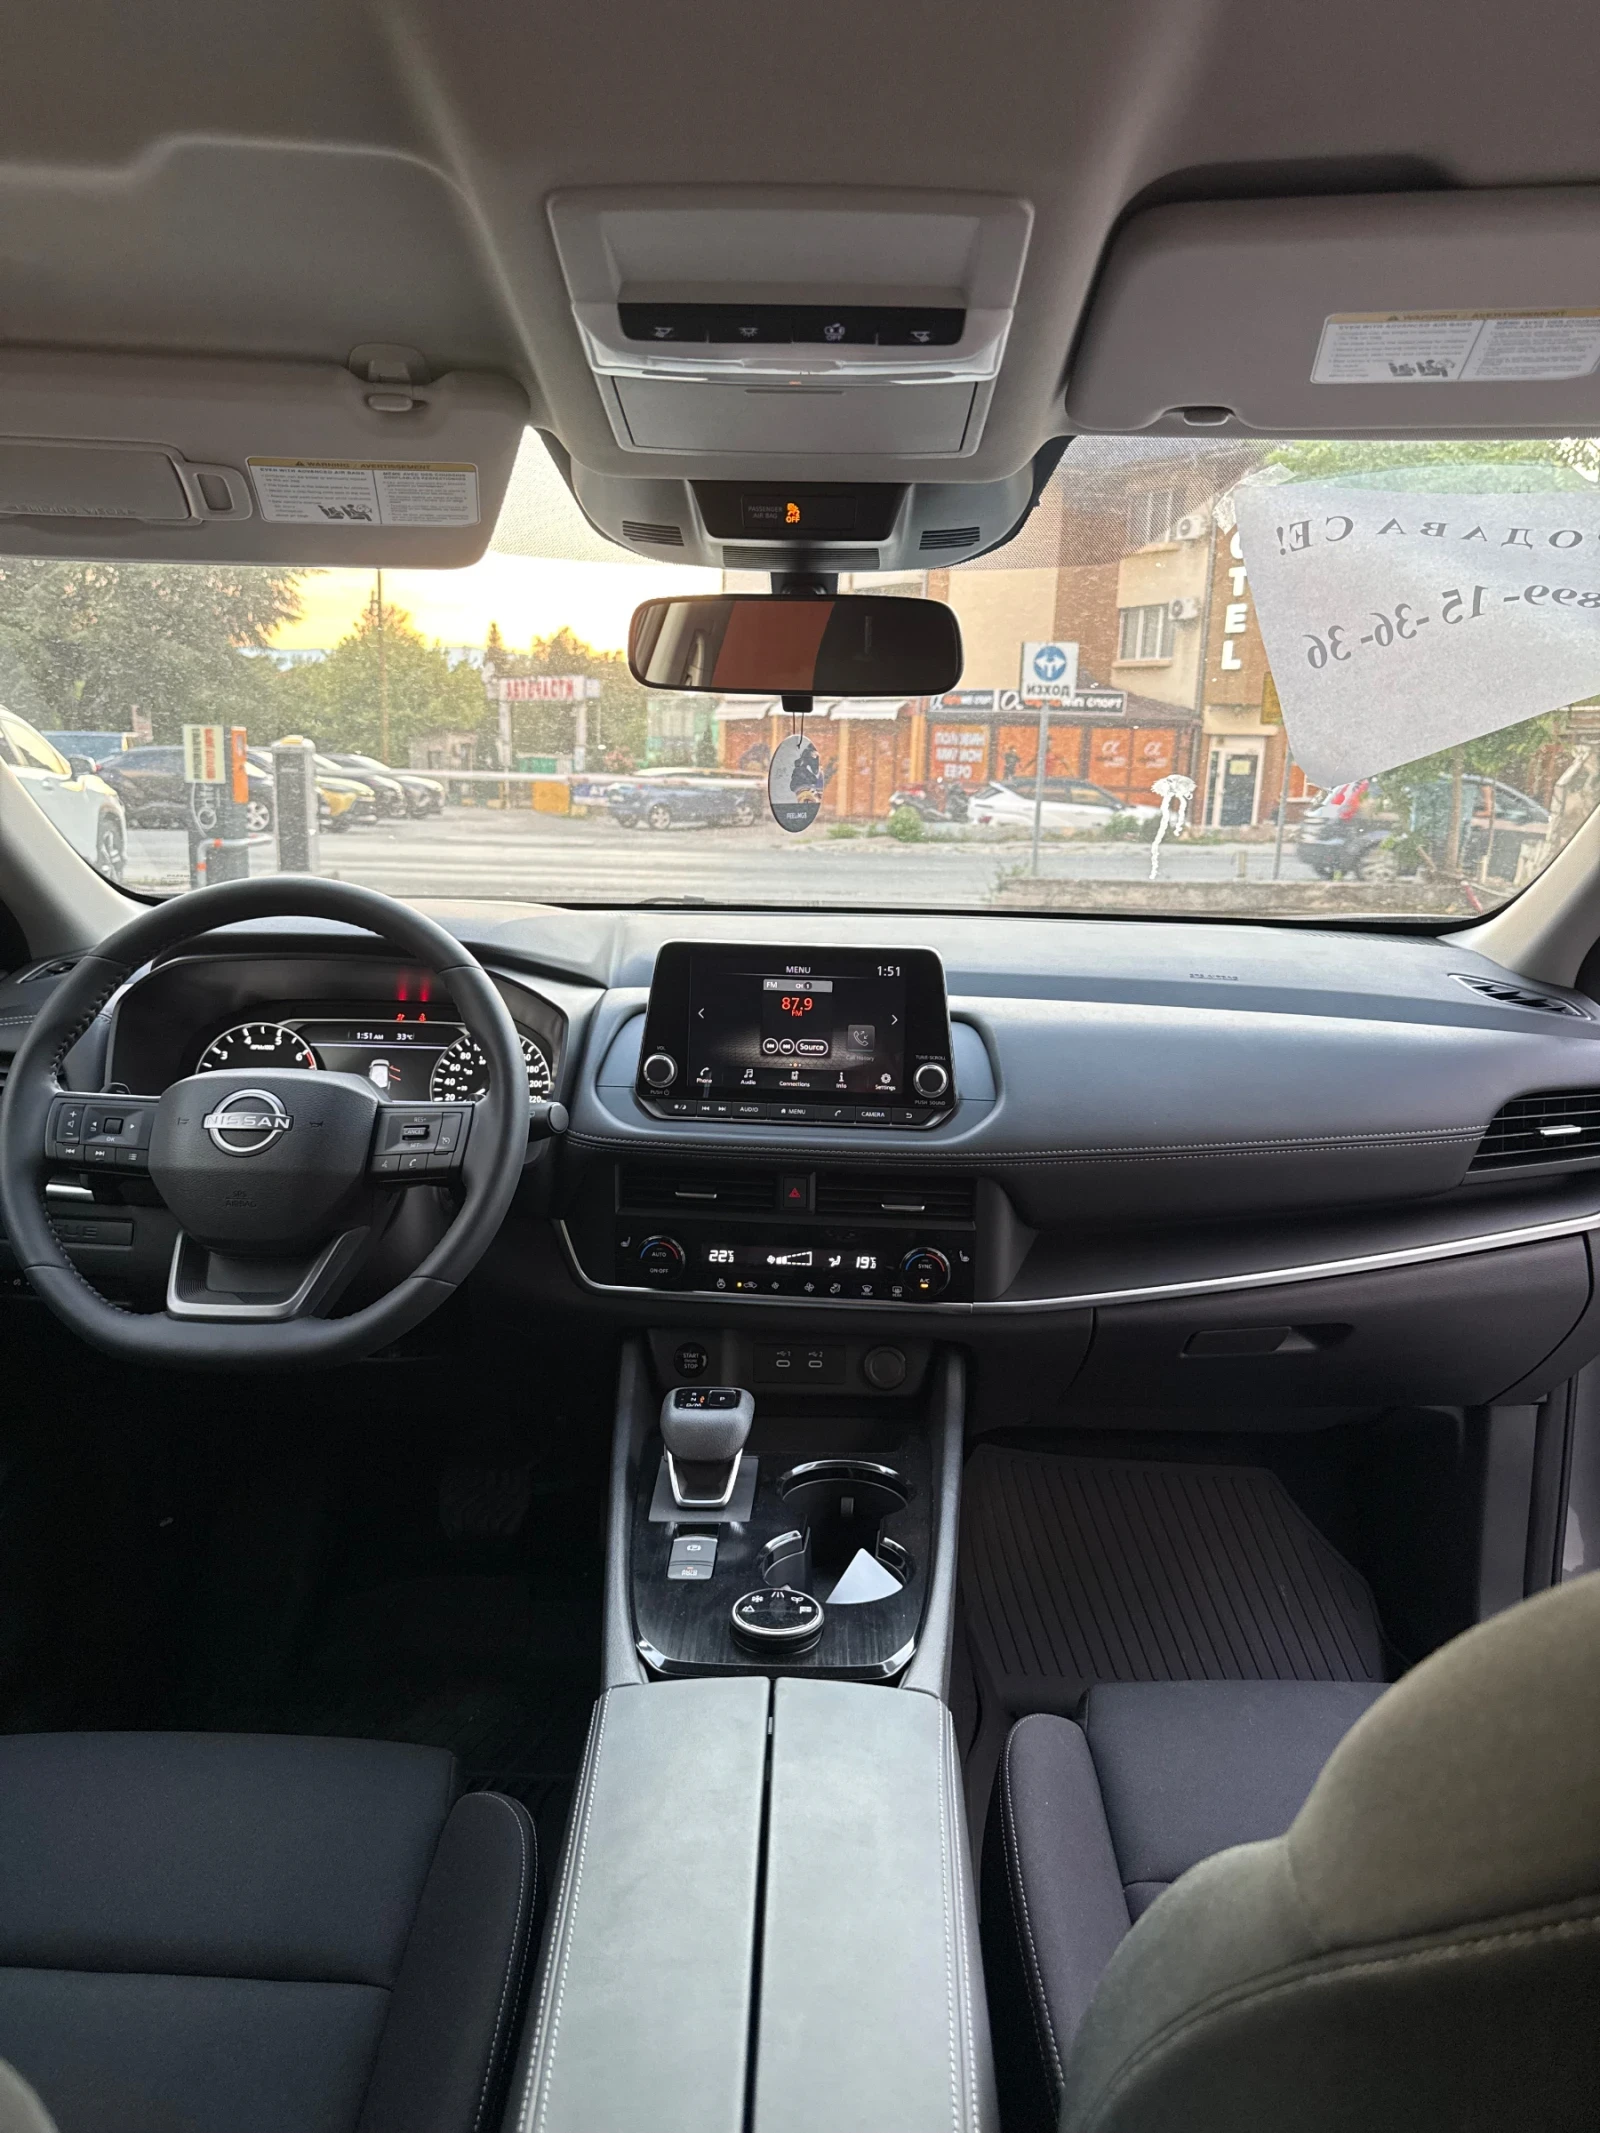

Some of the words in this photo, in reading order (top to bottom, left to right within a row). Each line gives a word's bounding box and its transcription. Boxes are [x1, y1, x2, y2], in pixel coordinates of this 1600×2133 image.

[307, 461, 350, 469] WARNING
[1026, 684, 1070, 697] ИЗХОД
[785, 965, 811, 974] MENU
[877, 965, 901, 977] 1:51
[766, 981, 778, 989] FM
[781, 996, 813, 1011] 87.9
[356, 1032, 373, 1040] 1:51
[243, 1036, 252, 1045] 4
[274, 1037, 282, 1045] 5
[799, 1042, 825, 1051] Source
[220, 1050, 228, 1060] 3
[295, 1052, 303, 1061] 6
[459, 1052, 471, 1060] 80
[449, 1063, 461, 1071] 60
[526, 1065, 540, 1073] 180
[444, 1077, 456, 1086] 40
[529, 1080, 543, 1088] 200
[779, 1080, 811, 1088] Connections
[875, 1084, 896, 1092] Settings
[444, 1093, 456, 1101] 20
[206, 1114, 291, 1129] NISSAN
